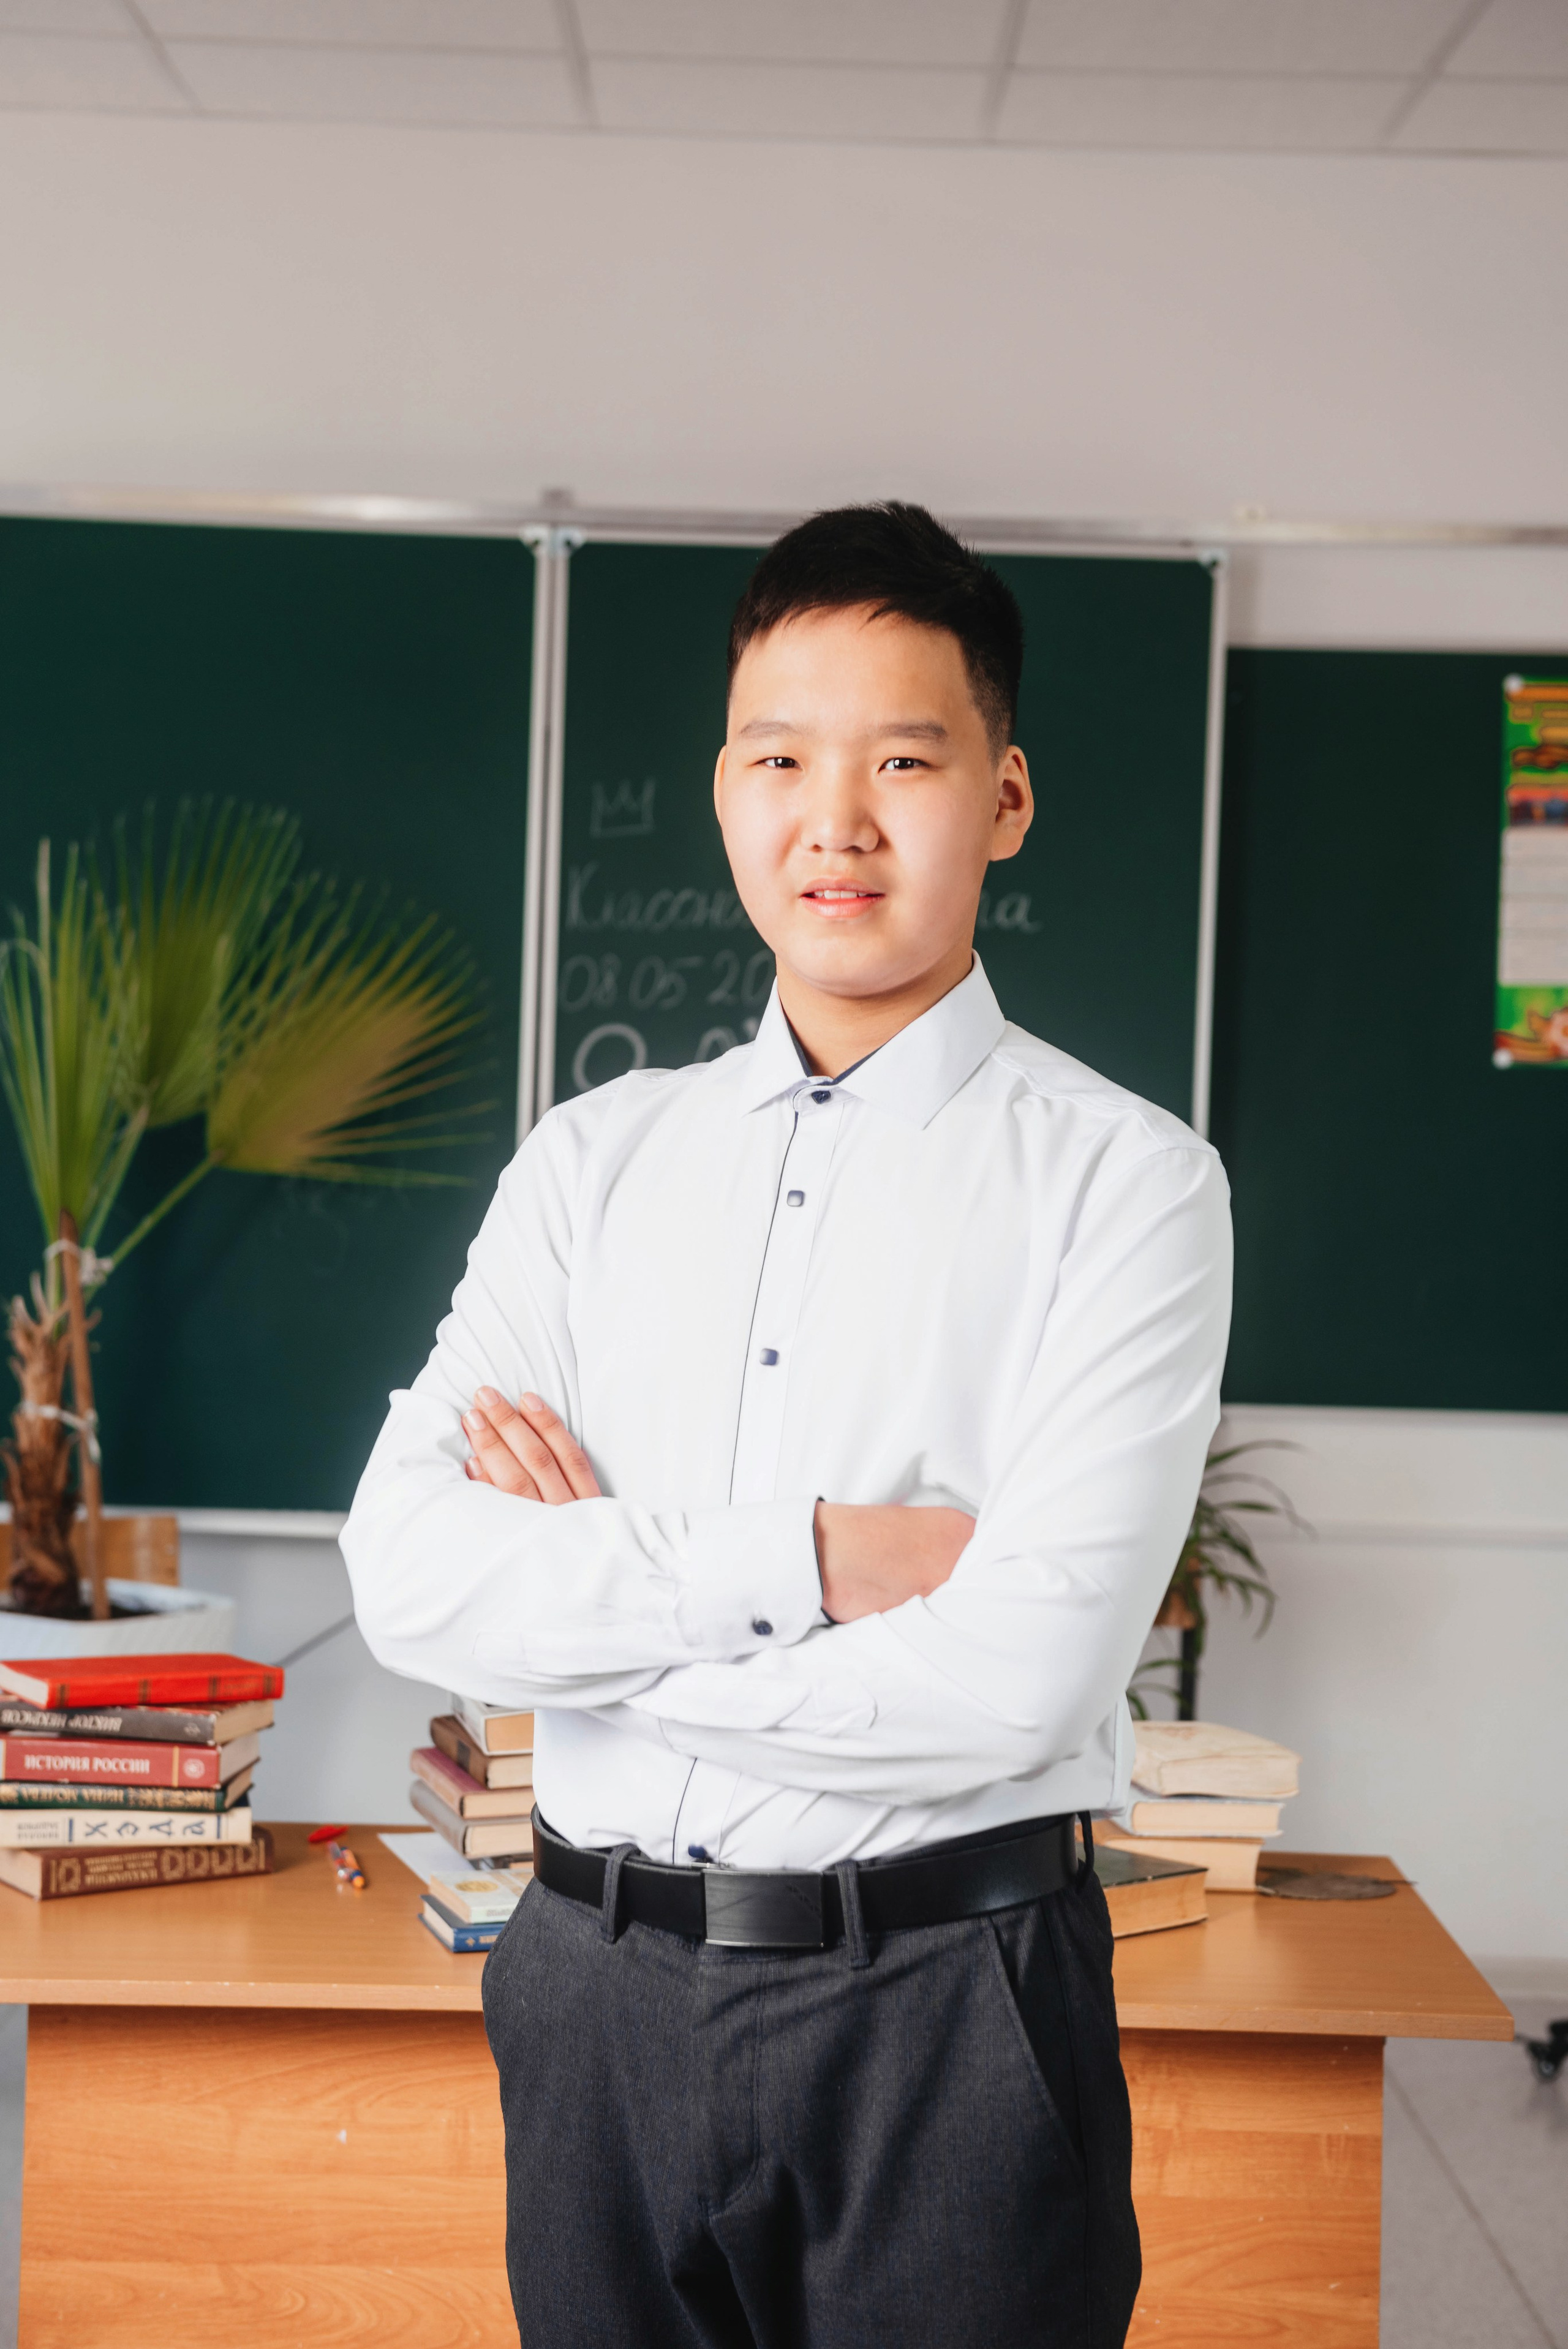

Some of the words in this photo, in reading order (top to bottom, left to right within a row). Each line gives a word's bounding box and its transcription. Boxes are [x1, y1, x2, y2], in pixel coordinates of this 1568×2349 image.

[706, 948, 777, 1008] 20
[69, 1713, 123, 1732] ВИКТОР
[24, 1754, 89, 1772] ИСТОРИЯ
[92, 1757, 150, 1774] РОССИИ
